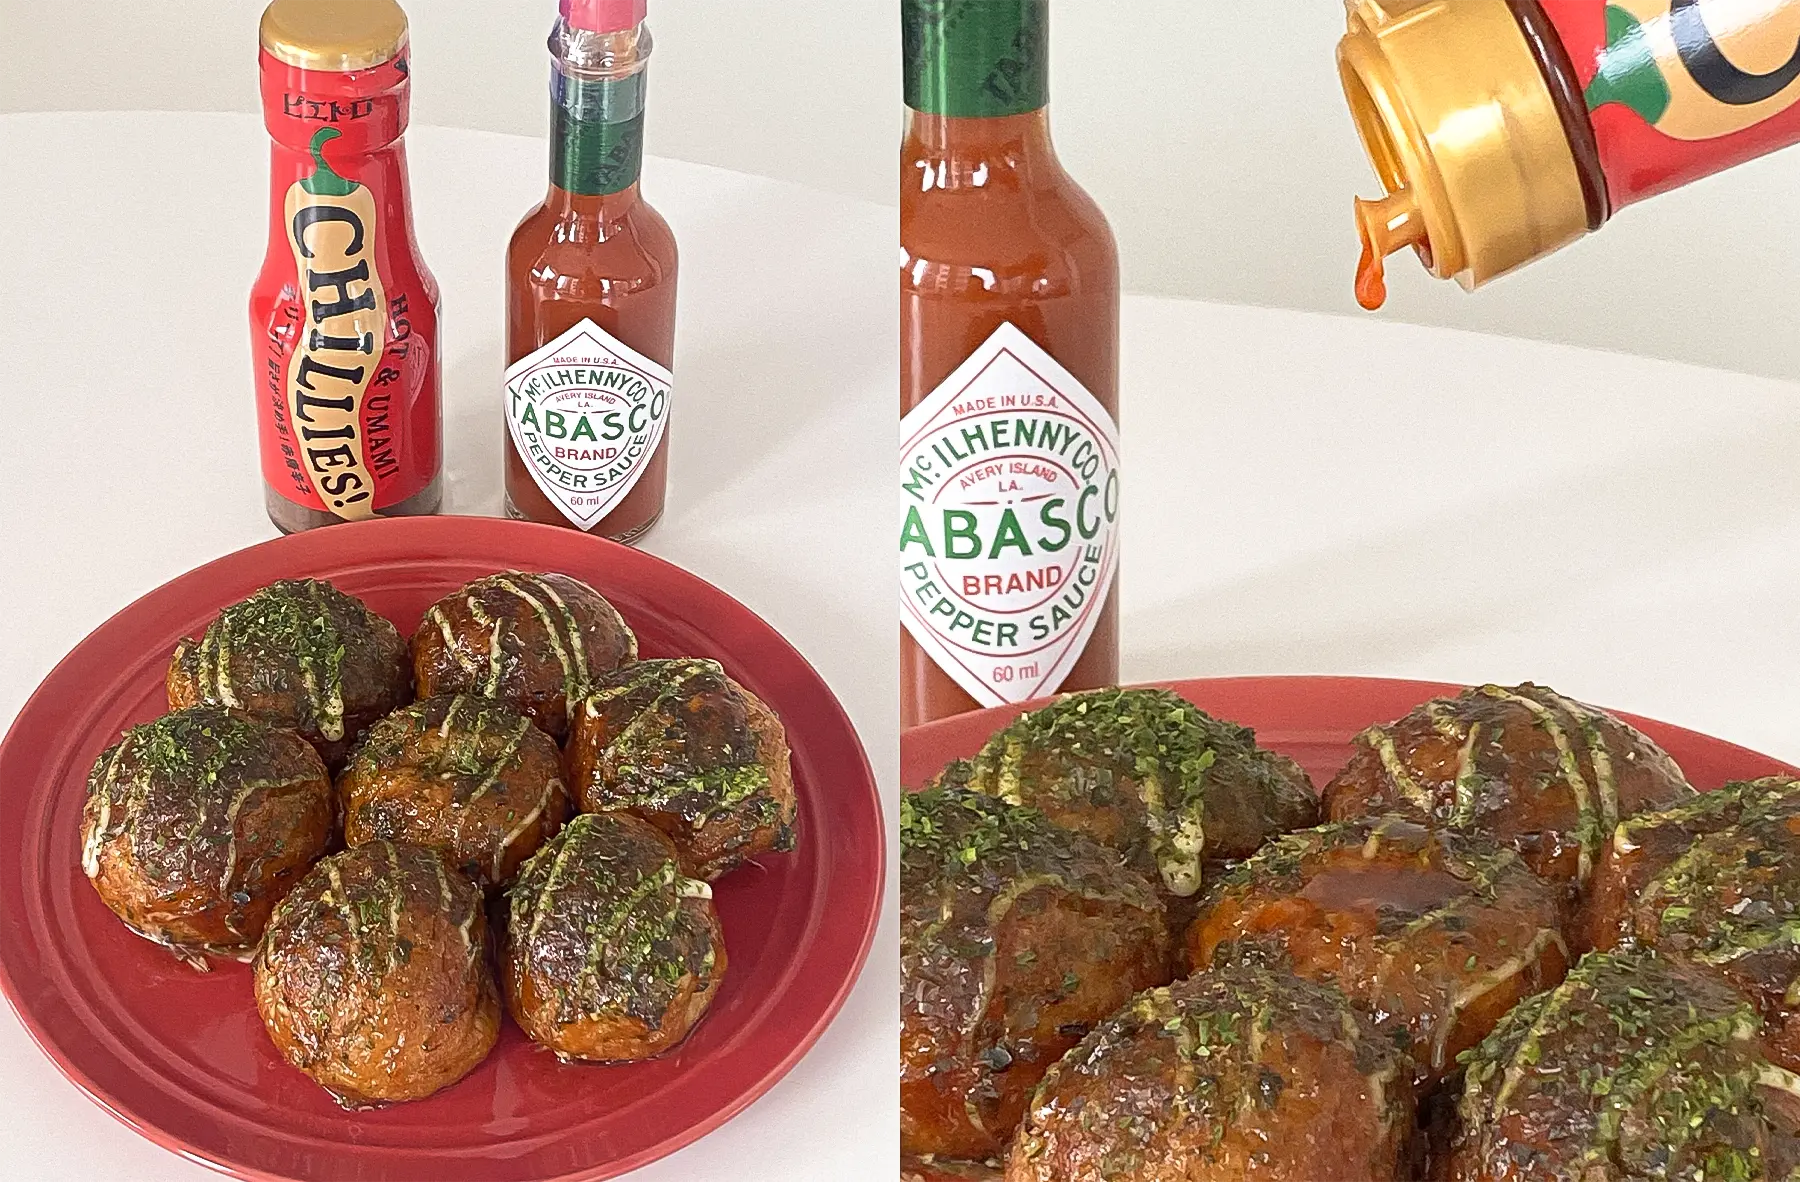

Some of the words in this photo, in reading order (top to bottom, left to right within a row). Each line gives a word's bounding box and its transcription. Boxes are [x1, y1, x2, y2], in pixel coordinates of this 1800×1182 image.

[388, 293, 412, 360] HOT
[292, 205, 376, 508] CHILLIES!
[552, 356, 578, 364] MADE
[374, 366, 400, 387] &
[555, 392, 582, 403] AVERY
[584, 392, 616, 405] ISLAND
[952, 397, 997, 416] MADE
[1001, 395, 1015, 407] IN
[508, 385, 665, 442] TABASCO
[366, 395, 400, 481] UMAMI
[524, 432, 588, 488] PEPPER
[593, 433, 647, 487] SAUCE
[554, 447, 618, 461] BRAND
[959, 463, 1003, 490] AVERY
[1009, 462, 1057, 483] ISLAND
[570, 496, 583, 506] 60
[586, 496, 599, 505] ml
[962, 565, 1062, 596] BRAND
[904, 561, 1019, 647] PEPPER
[1029, 544, 1103, 641] SAUCE
[992, 665, 1014, 682] 60
[1018, 661, 1039, 679] ml
